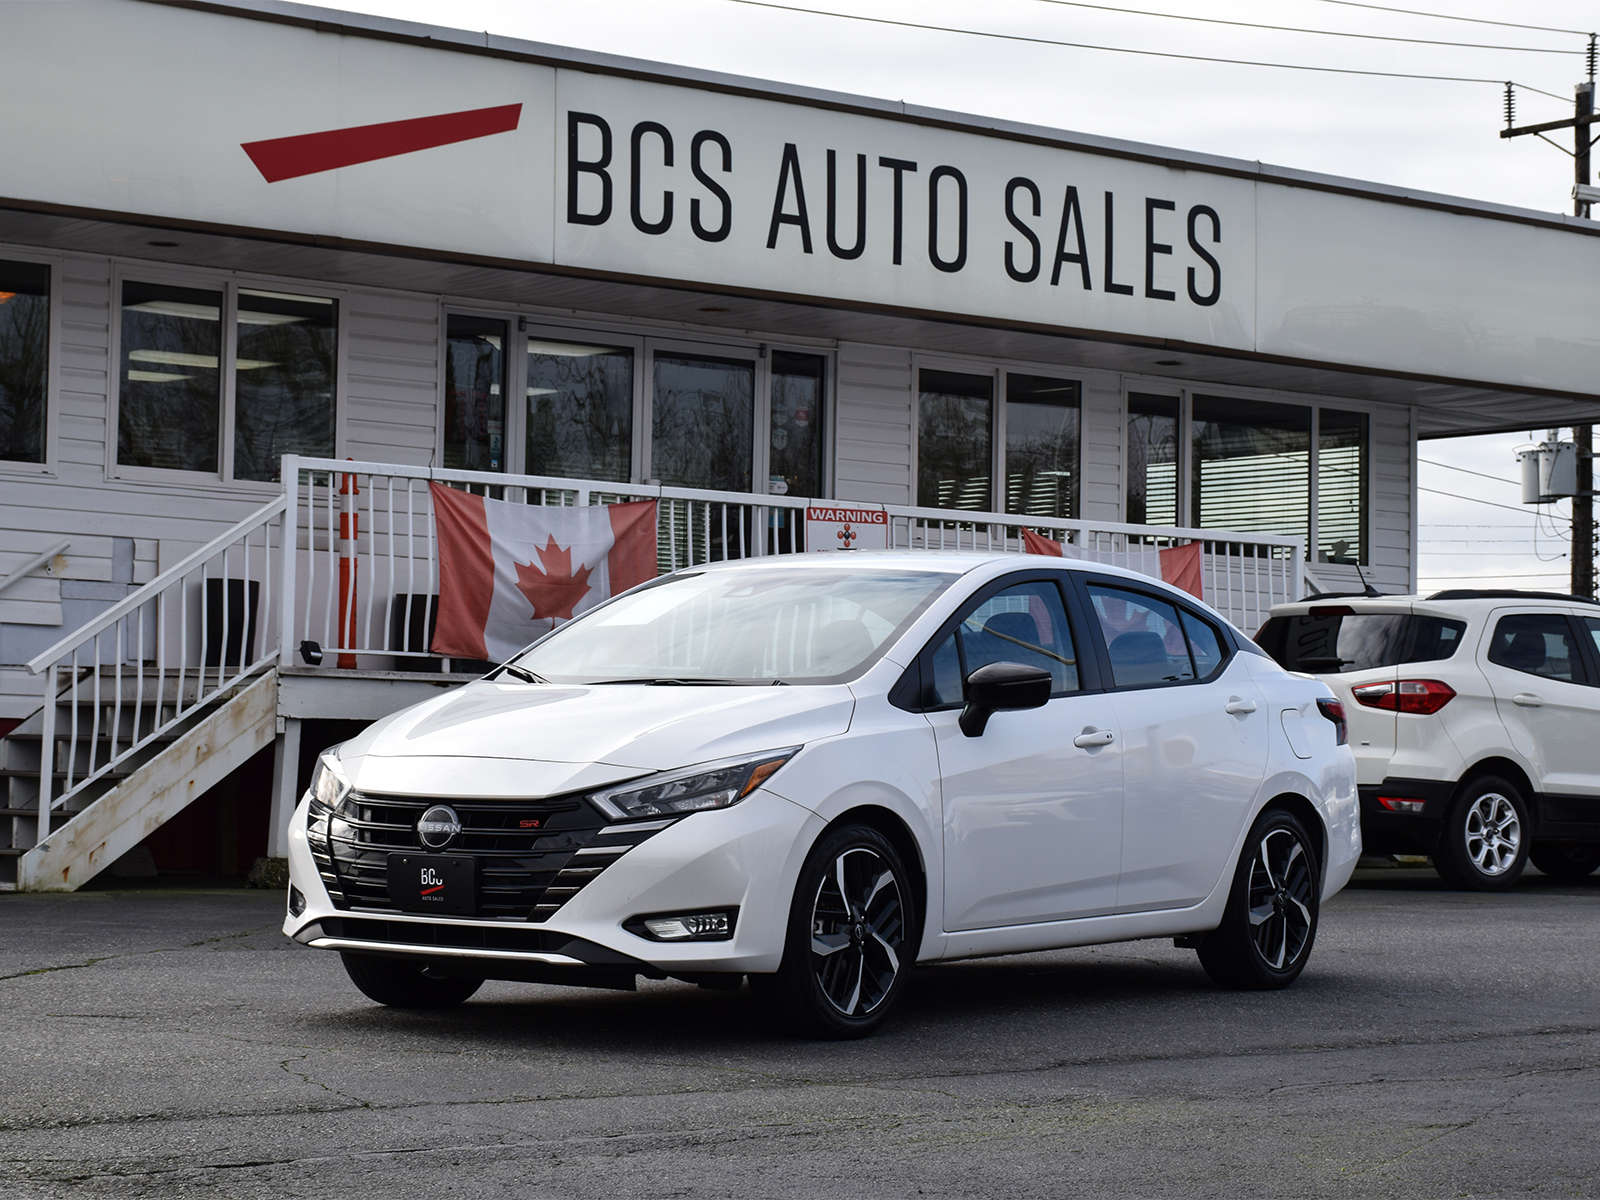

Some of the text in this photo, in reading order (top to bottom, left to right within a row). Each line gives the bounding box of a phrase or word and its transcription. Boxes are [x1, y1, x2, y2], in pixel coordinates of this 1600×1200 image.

[567, 111, 1222, 306] BCS AUTO SALES
[810, 509, 883, 523] WARNING
[418, 822, 460, 832] NISSAN
[519, 820, 539, 828] SR
